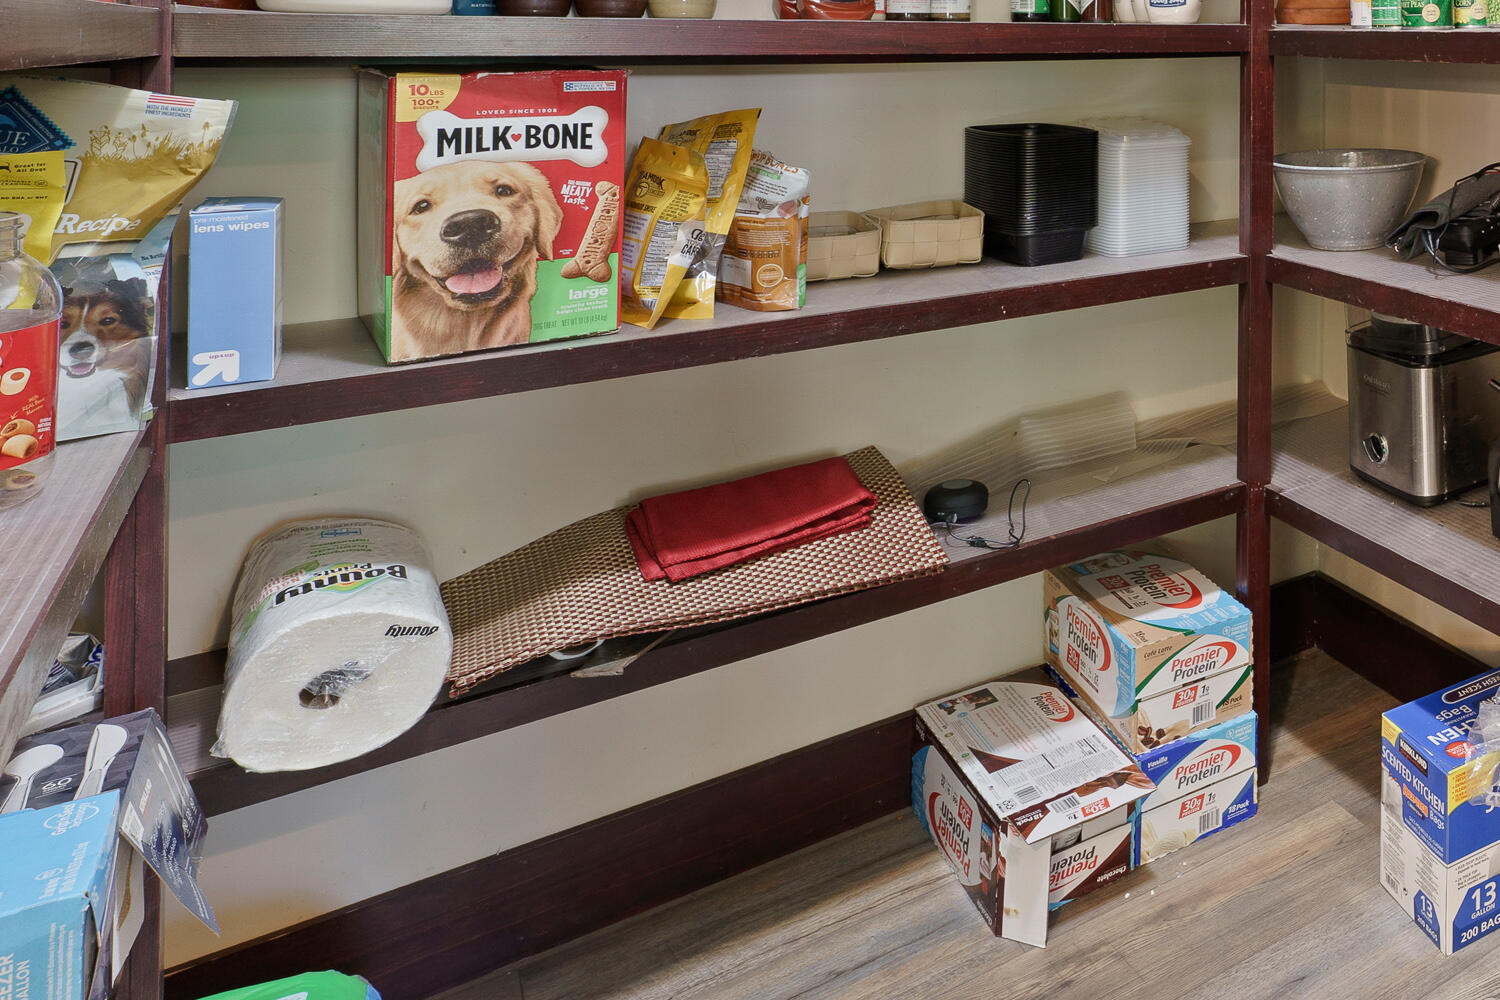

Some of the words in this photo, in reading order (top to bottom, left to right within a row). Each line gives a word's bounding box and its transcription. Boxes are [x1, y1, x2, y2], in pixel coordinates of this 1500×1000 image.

[408, 84, 429, 96] 10
[411, 98, 440, 106] 100+
[436, 125, 513, 158] MILK
[525, 122, 593, 150] BONE
[560, 183, 593, 198] MEATY
[563, 194, 587, 206] Taste
[54, 213, 142, 236] Recipe
[193, 222, 223, 234] lens
[227, 219, 270, 234] wipes
[569, 286, 609, 300] large
[274, 564, 408, 607] Bounty
[1125, 569, 1168, 600] Protein
[1141, 562, 1191, 598] Premier
[385, 624, 439, 638] Bounty
[1066, 604, 1101, 649] Premier
[1067, 622, 1098, 665] Protein
[1171, 647, 1222, 673] Premier
[1173, 660, 1217, 682] Protein
[1177, 687, 1196, 702] 30g
[1200, 684, 1210, 694] 1g
[1435, 704, 1473, 722] Bags
[1147, 755, 1169, 769] Vanilla
[1399, 739, 1428, 770] KIRKLAND
[1174, 750, 1227, 781] Premier
[1177, 764, 1221, 790] Protein
[1381, 745, 1412, 783] SCENTED
[1412, 775, 1445, 815] KITCHEN
[1429, 809, 1445, 830] Bags
[1096, 864, 1128, 883] Chocolate
[1471, 881, 1497, 911] 13
[1471, 903, 1496, 919] GALLON
[1460, 926, 1479, 943] 200
